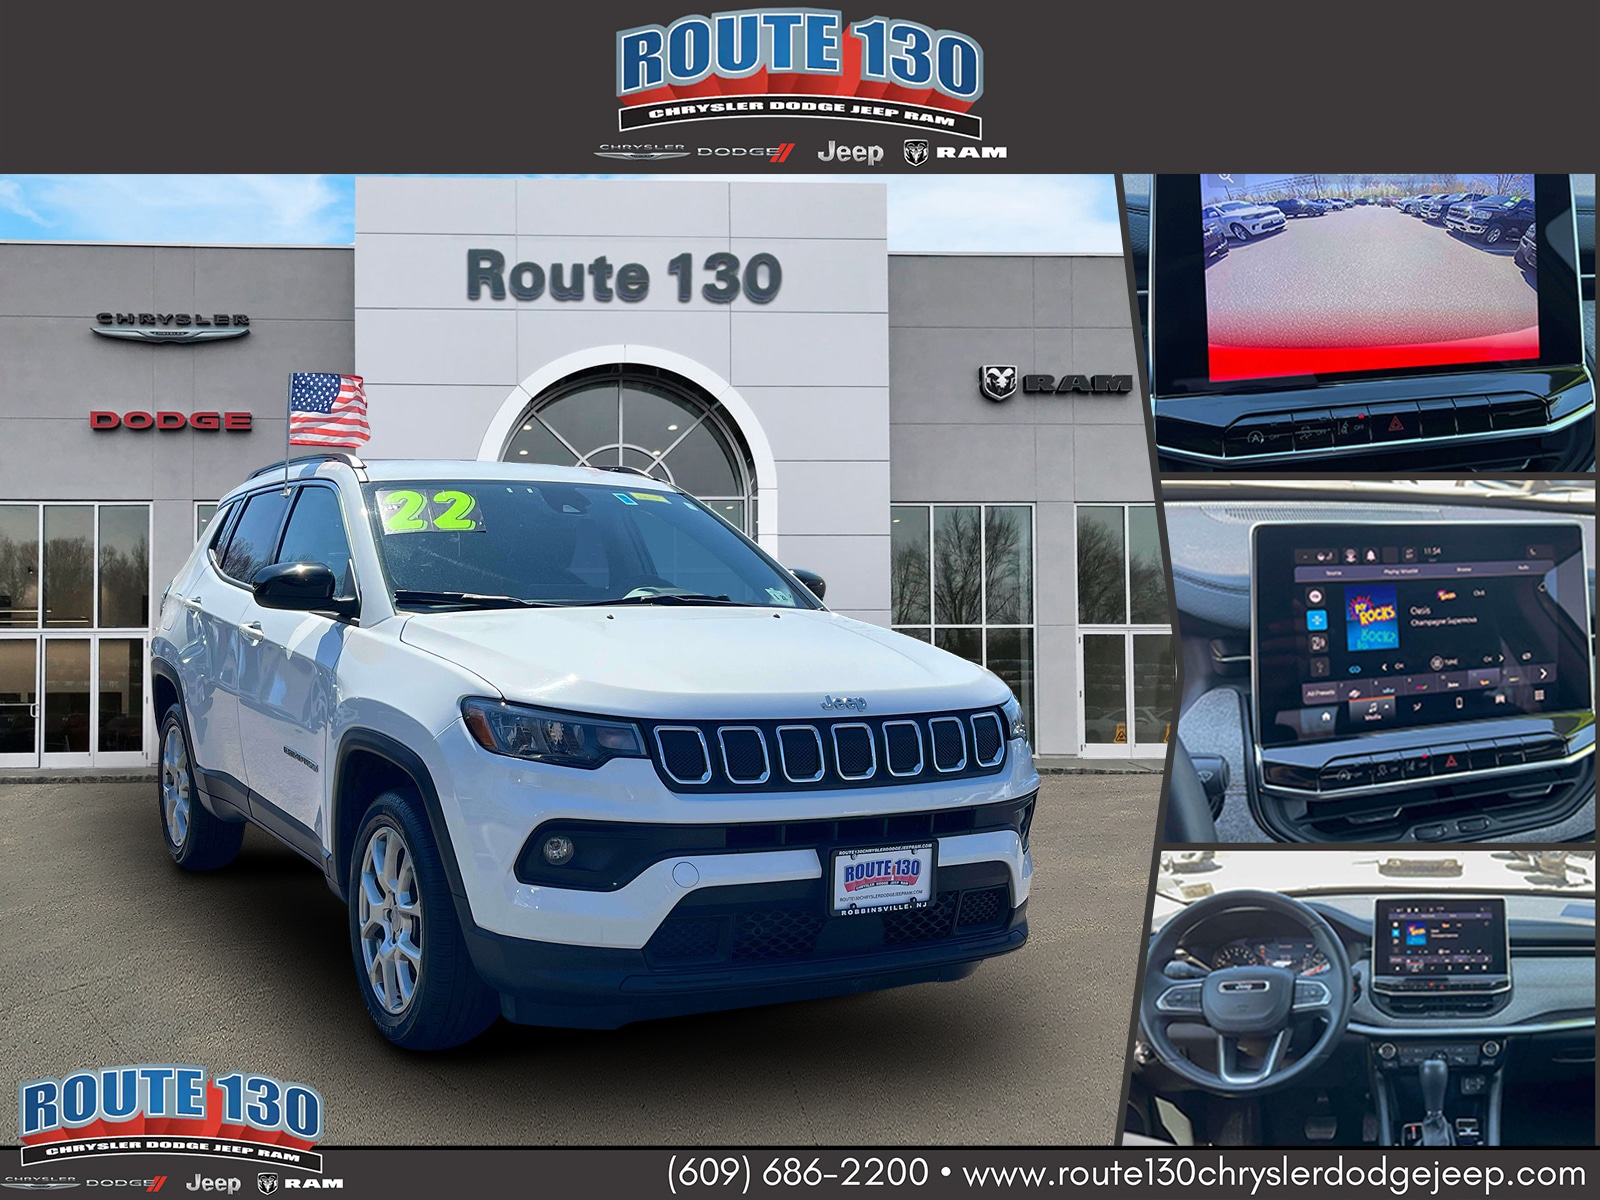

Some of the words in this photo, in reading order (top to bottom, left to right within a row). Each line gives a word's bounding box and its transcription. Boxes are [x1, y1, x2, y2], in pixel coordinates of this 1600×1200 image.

[467, 248, 649, 301] Route
[668, 252, 782, 304] 130
[96, 312, 249, 326] CHRYSLER
[1022, 374, 1133, 395] RAM
[90, 411, 252, 432] DODGE
[383, 489, 477, 531] 22
[1359, 604, 1396, 626] ROCKS
[820, 694, 867, 712] Jeep
[845, 860, 891, 882] ROUTE
[894, 859, 920, 876] 130
[841, 904, 912, 916] ROBBINSVILLE,
